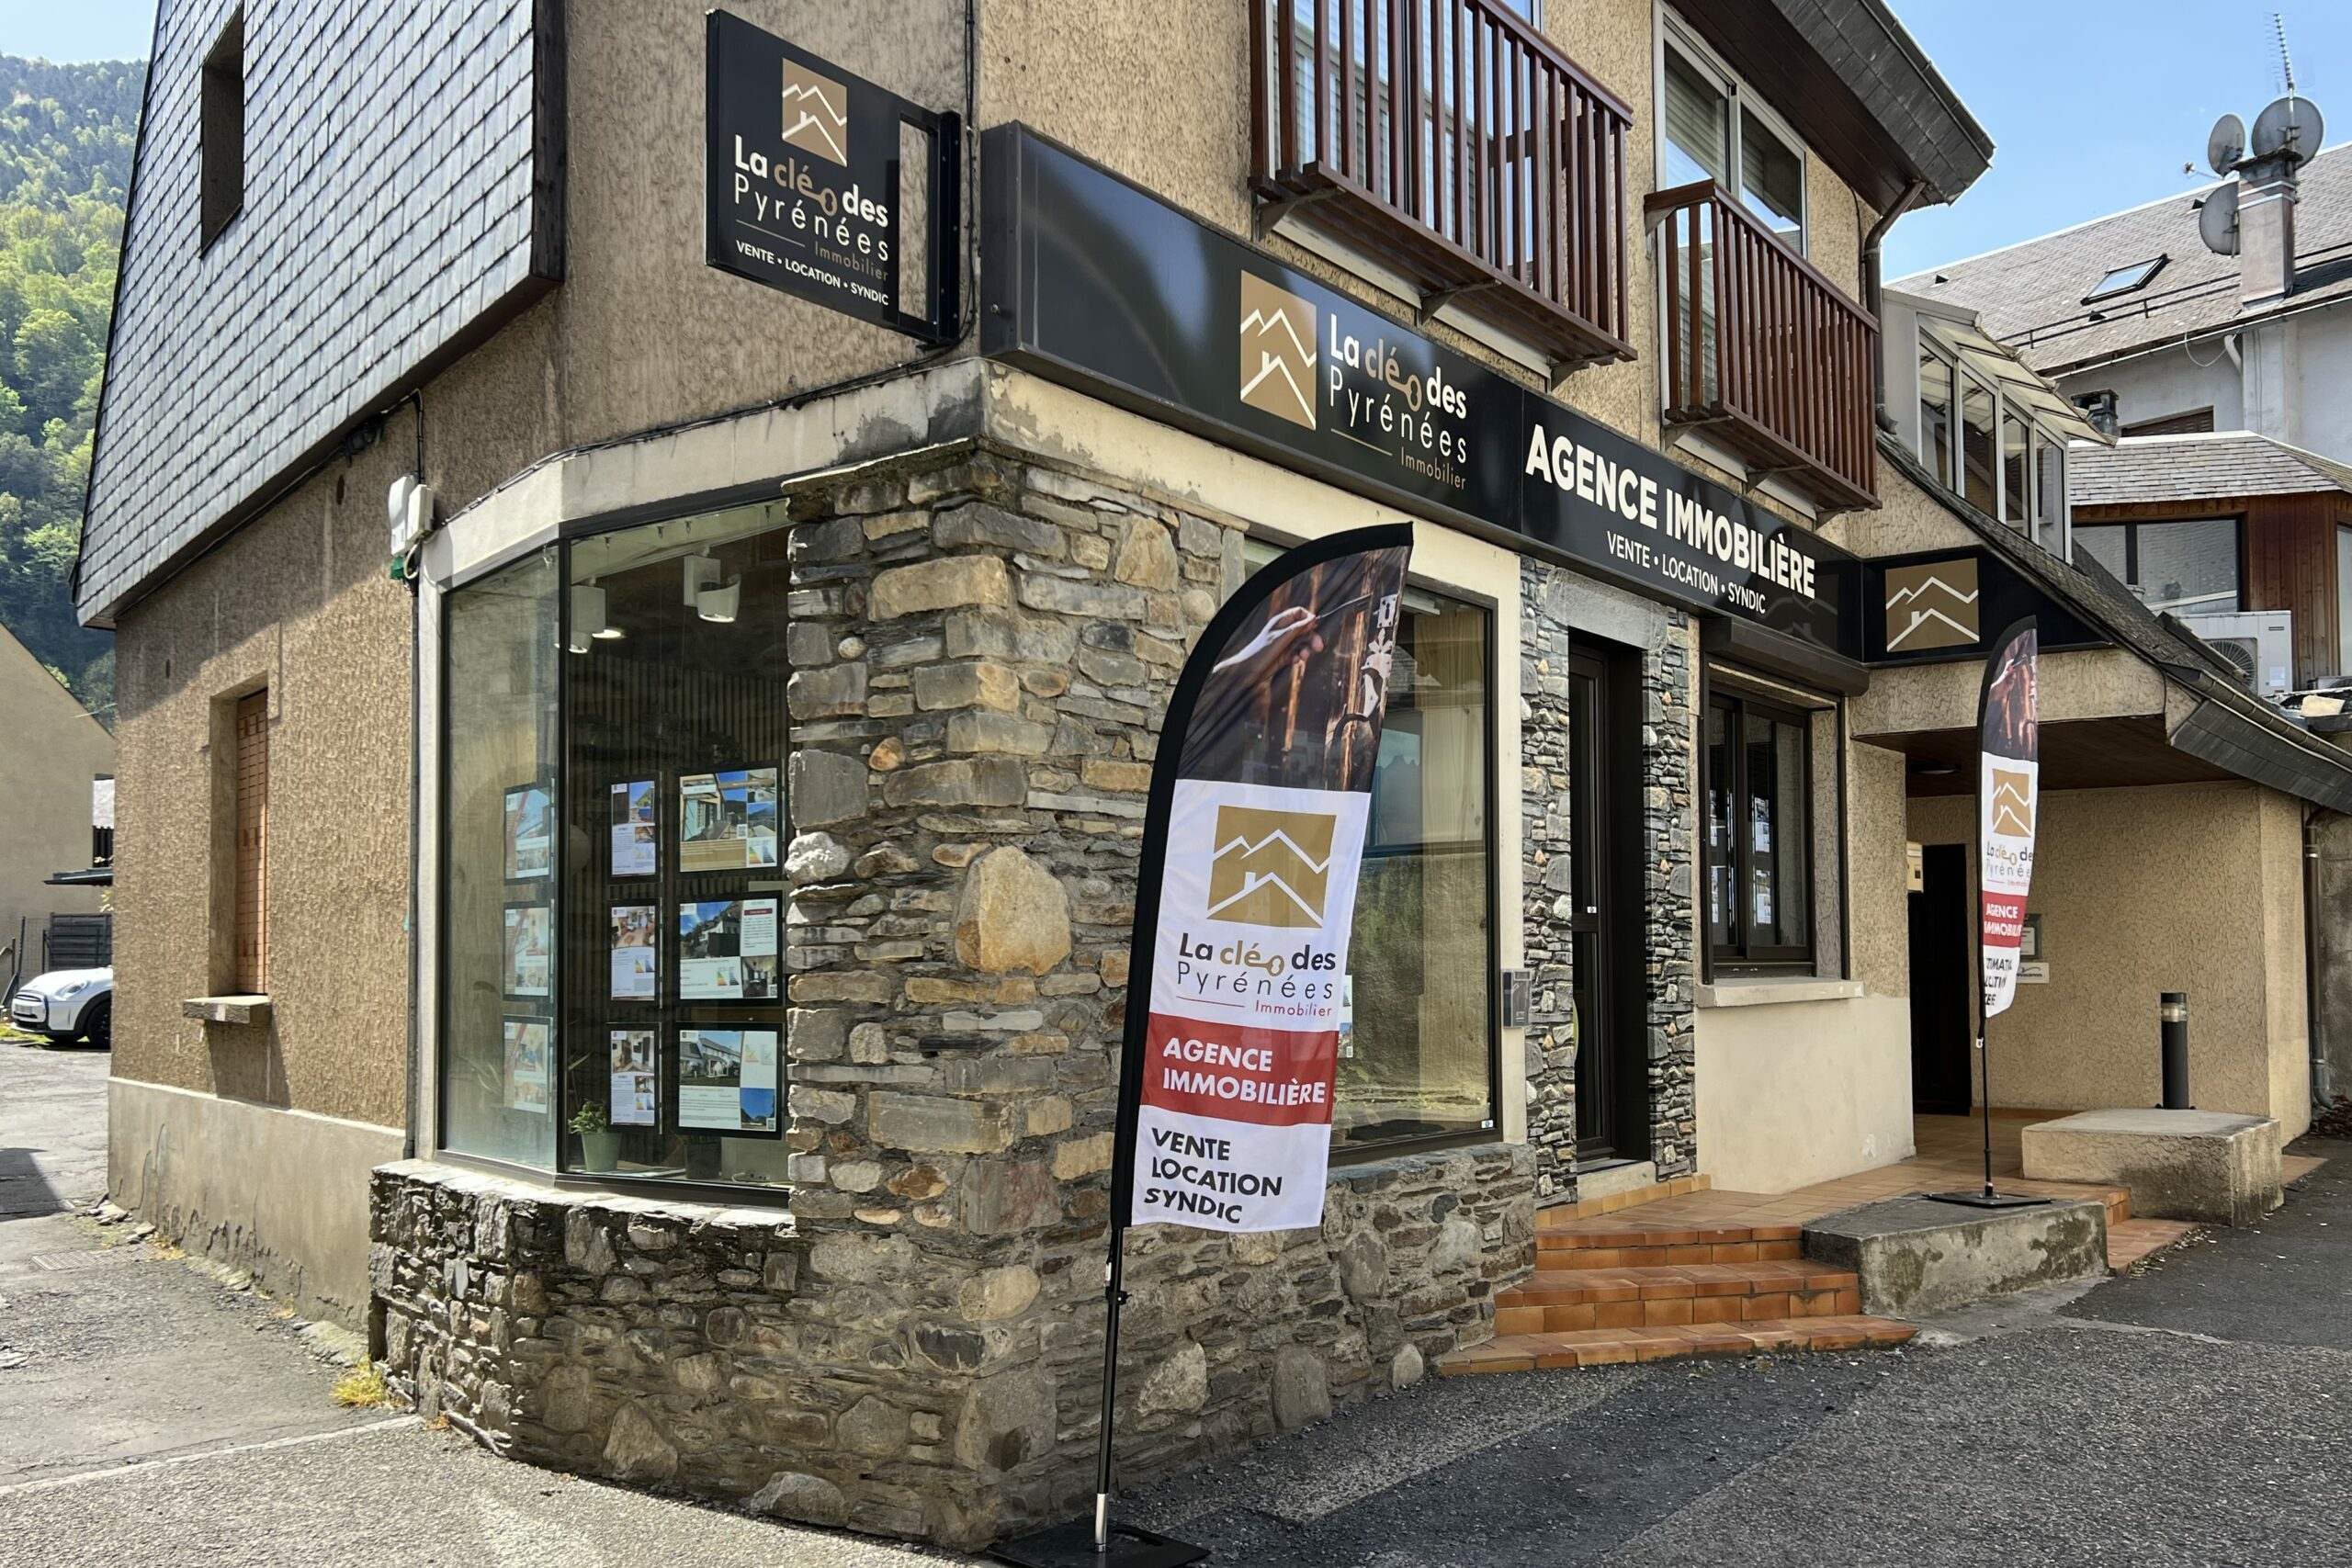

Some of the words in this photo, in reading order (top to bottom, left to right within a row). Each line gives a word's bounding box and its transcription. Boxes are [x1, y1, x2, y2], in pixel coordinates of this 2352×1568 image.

[735, 134, 768, 178] La
[774, 157, 822, 203] clé
[842, 184, 888, 228] des
[735, 172, 888, 261] Pyrénées
[736, 239, 775, 265] VENTE
[785, 257, 842, 288] LOCATION
[850, 281, 889, 306] SYNDIC
[815, 241, 888, 282] Immobilier
[1330, 312, 1360, 368] La
[1364, 338, 1408, 395] clé
[1426, 367, 1467, 419] des
[1330, 365, 1466, 464] Pyrénées
[1400, 446, 1466, 491] Immobilier
[1525, 423, 1657, 530] AGENCE
[1665, 487, 1815, 599] IMMOBILIÈRE
[1607, 530, 1651, 569] VENTE
[1661, 553, 1719, 596] LOCATION
[1727, 581, 1766, 615] SYNDIC
[1985, 858, 2031, 877] Pyrénée
[2019, 846, 2033, 862] de
[1985, 903, 2018, 919] AGENCE
[1179, 932, 1213, 961] La
[1220, 941, 1270, 969] clé
[1291, 944, 1337, 971] des
[1177, 961, 1333, 999] Pyrénées
[1255, 999, 1332, 1017] Immobilier
[1162, 1037, 1273, 1073] AGENCE
[1162, 1067, 1326, 1106] IMMOBILIÈRE
[1151, 1127, 1231, 1161] VENTE
[1152, 1156, 1283, 1197] LOCATION
[1144, 1187, 1243, 1224] SYNDIC
